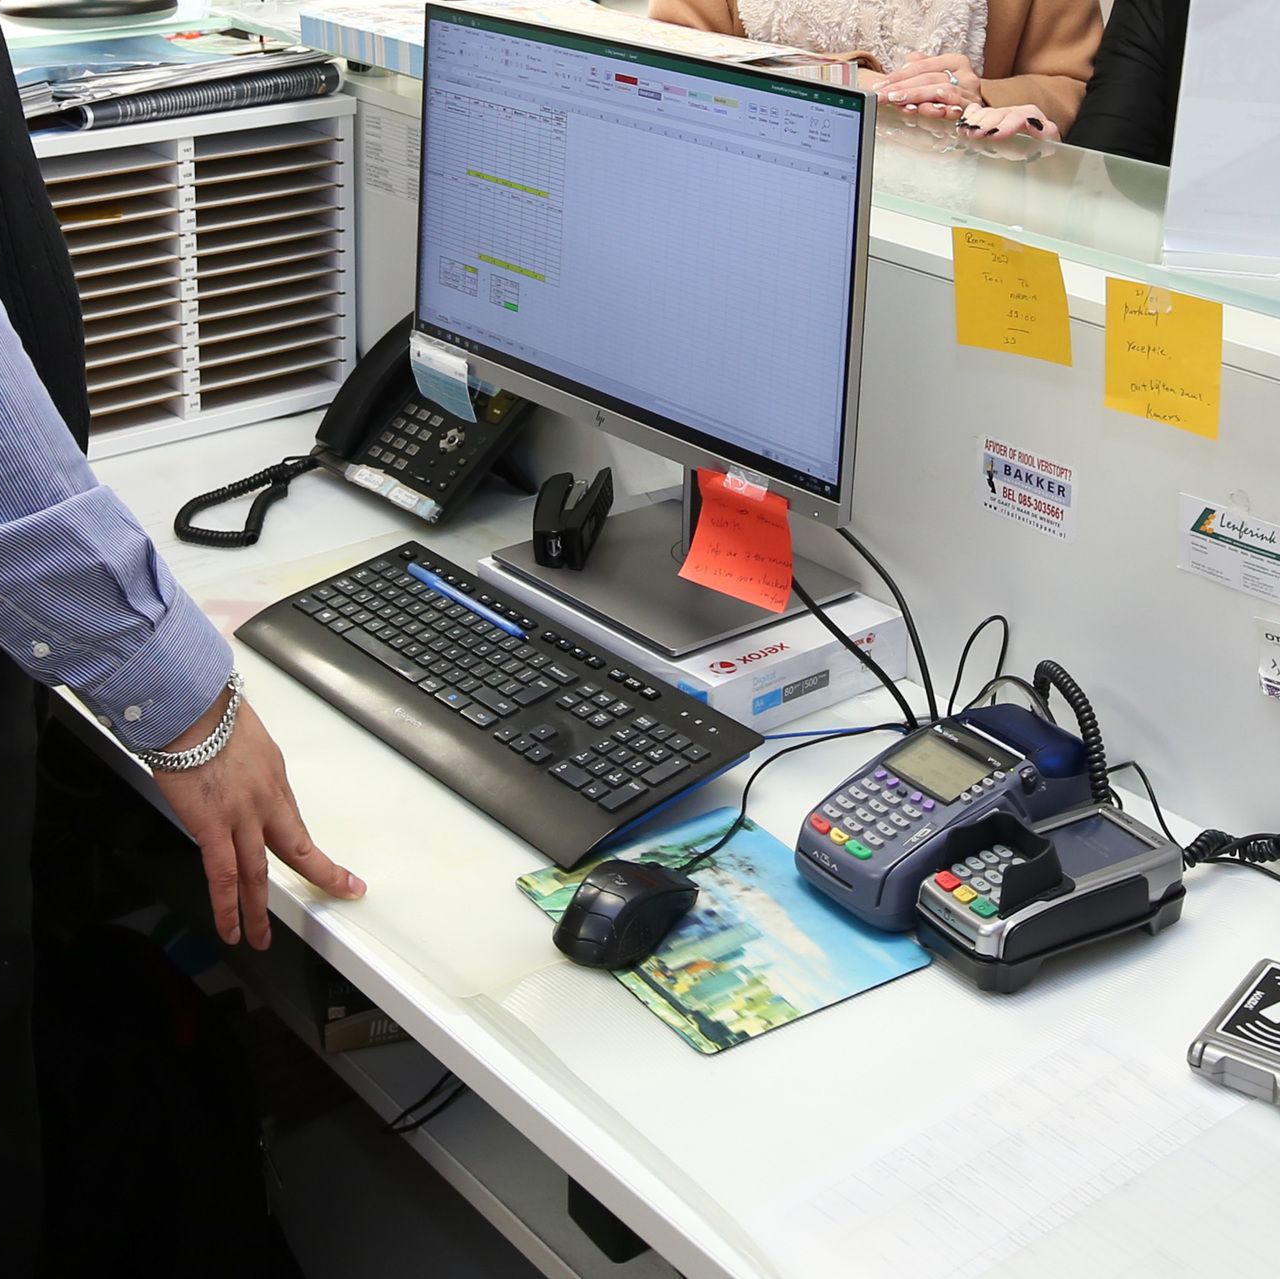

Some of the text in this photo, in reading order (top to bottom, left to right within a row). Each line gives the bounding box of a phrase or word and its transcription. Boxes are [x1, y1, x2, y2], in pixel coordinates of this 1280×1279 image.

[984, 438, 1073, 482] AFVOER OF RIOOL VERSTOPT?
[1003, 463, 1066, 498] BAKKER
[1002, 486, 1064, 521] BEL 085-3035661
[1219, 513, 1277, 544] Lenferink
[736, 642, 791, 665] xerox
[783, 685, 794, 697] 80
[804, 677, 818, 689] 500
